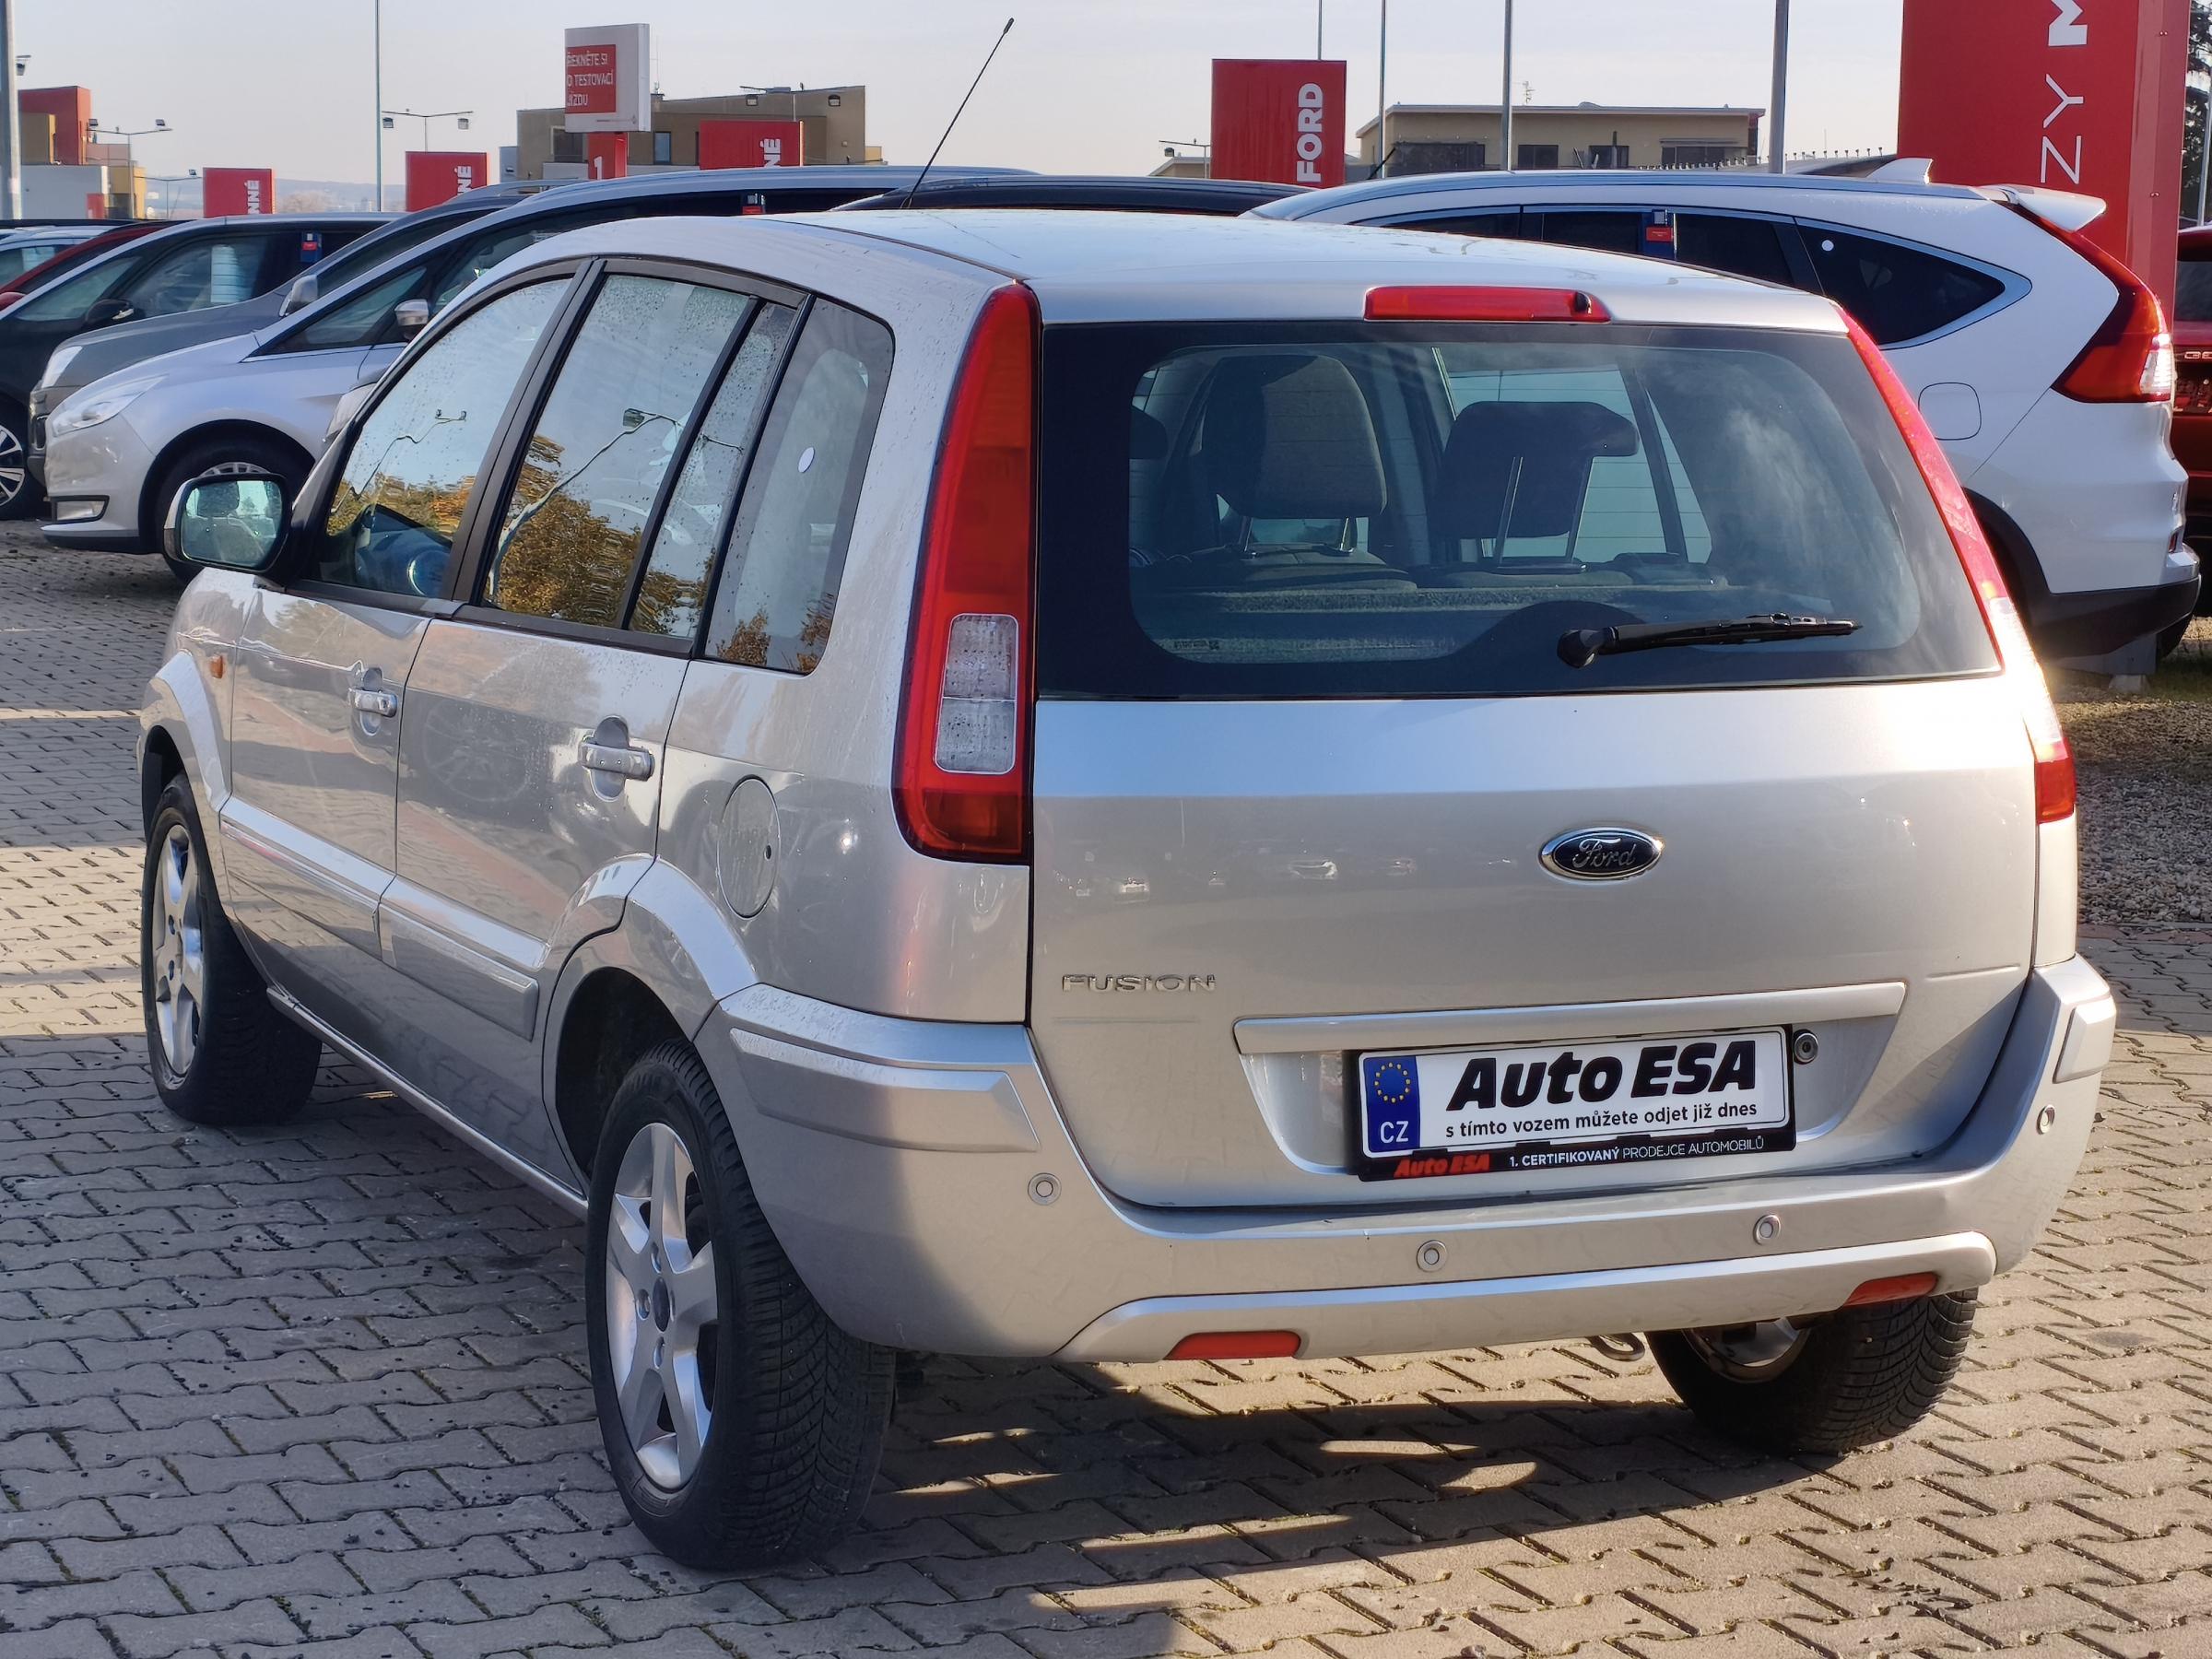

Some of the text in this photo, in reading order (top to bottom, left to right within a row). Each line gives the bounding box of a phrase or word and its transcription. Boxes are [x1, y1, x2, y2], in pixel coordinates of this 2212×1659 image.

[574, 70, 614, 87] TESTOVACÍ
[1296, 82, 1324, 182] FORD
[1571, 838, 1637, 869] Ford
[1062, 974, 1216, 993] FUSION
[1446, 1040, 1756, 1112] Auto ESA
[1380, 1121, 1409, 1144] CZ
[1445, 1101, 1757, 1138] s tímto vozem můžete odjet již dnes
[1393, 1153, 1491, 1179] Auto ESA
[1510, 1135, 1764, 1167] 1. CERTIFIKOVANÝ PRODEJCE AUTOMOBILŮ
